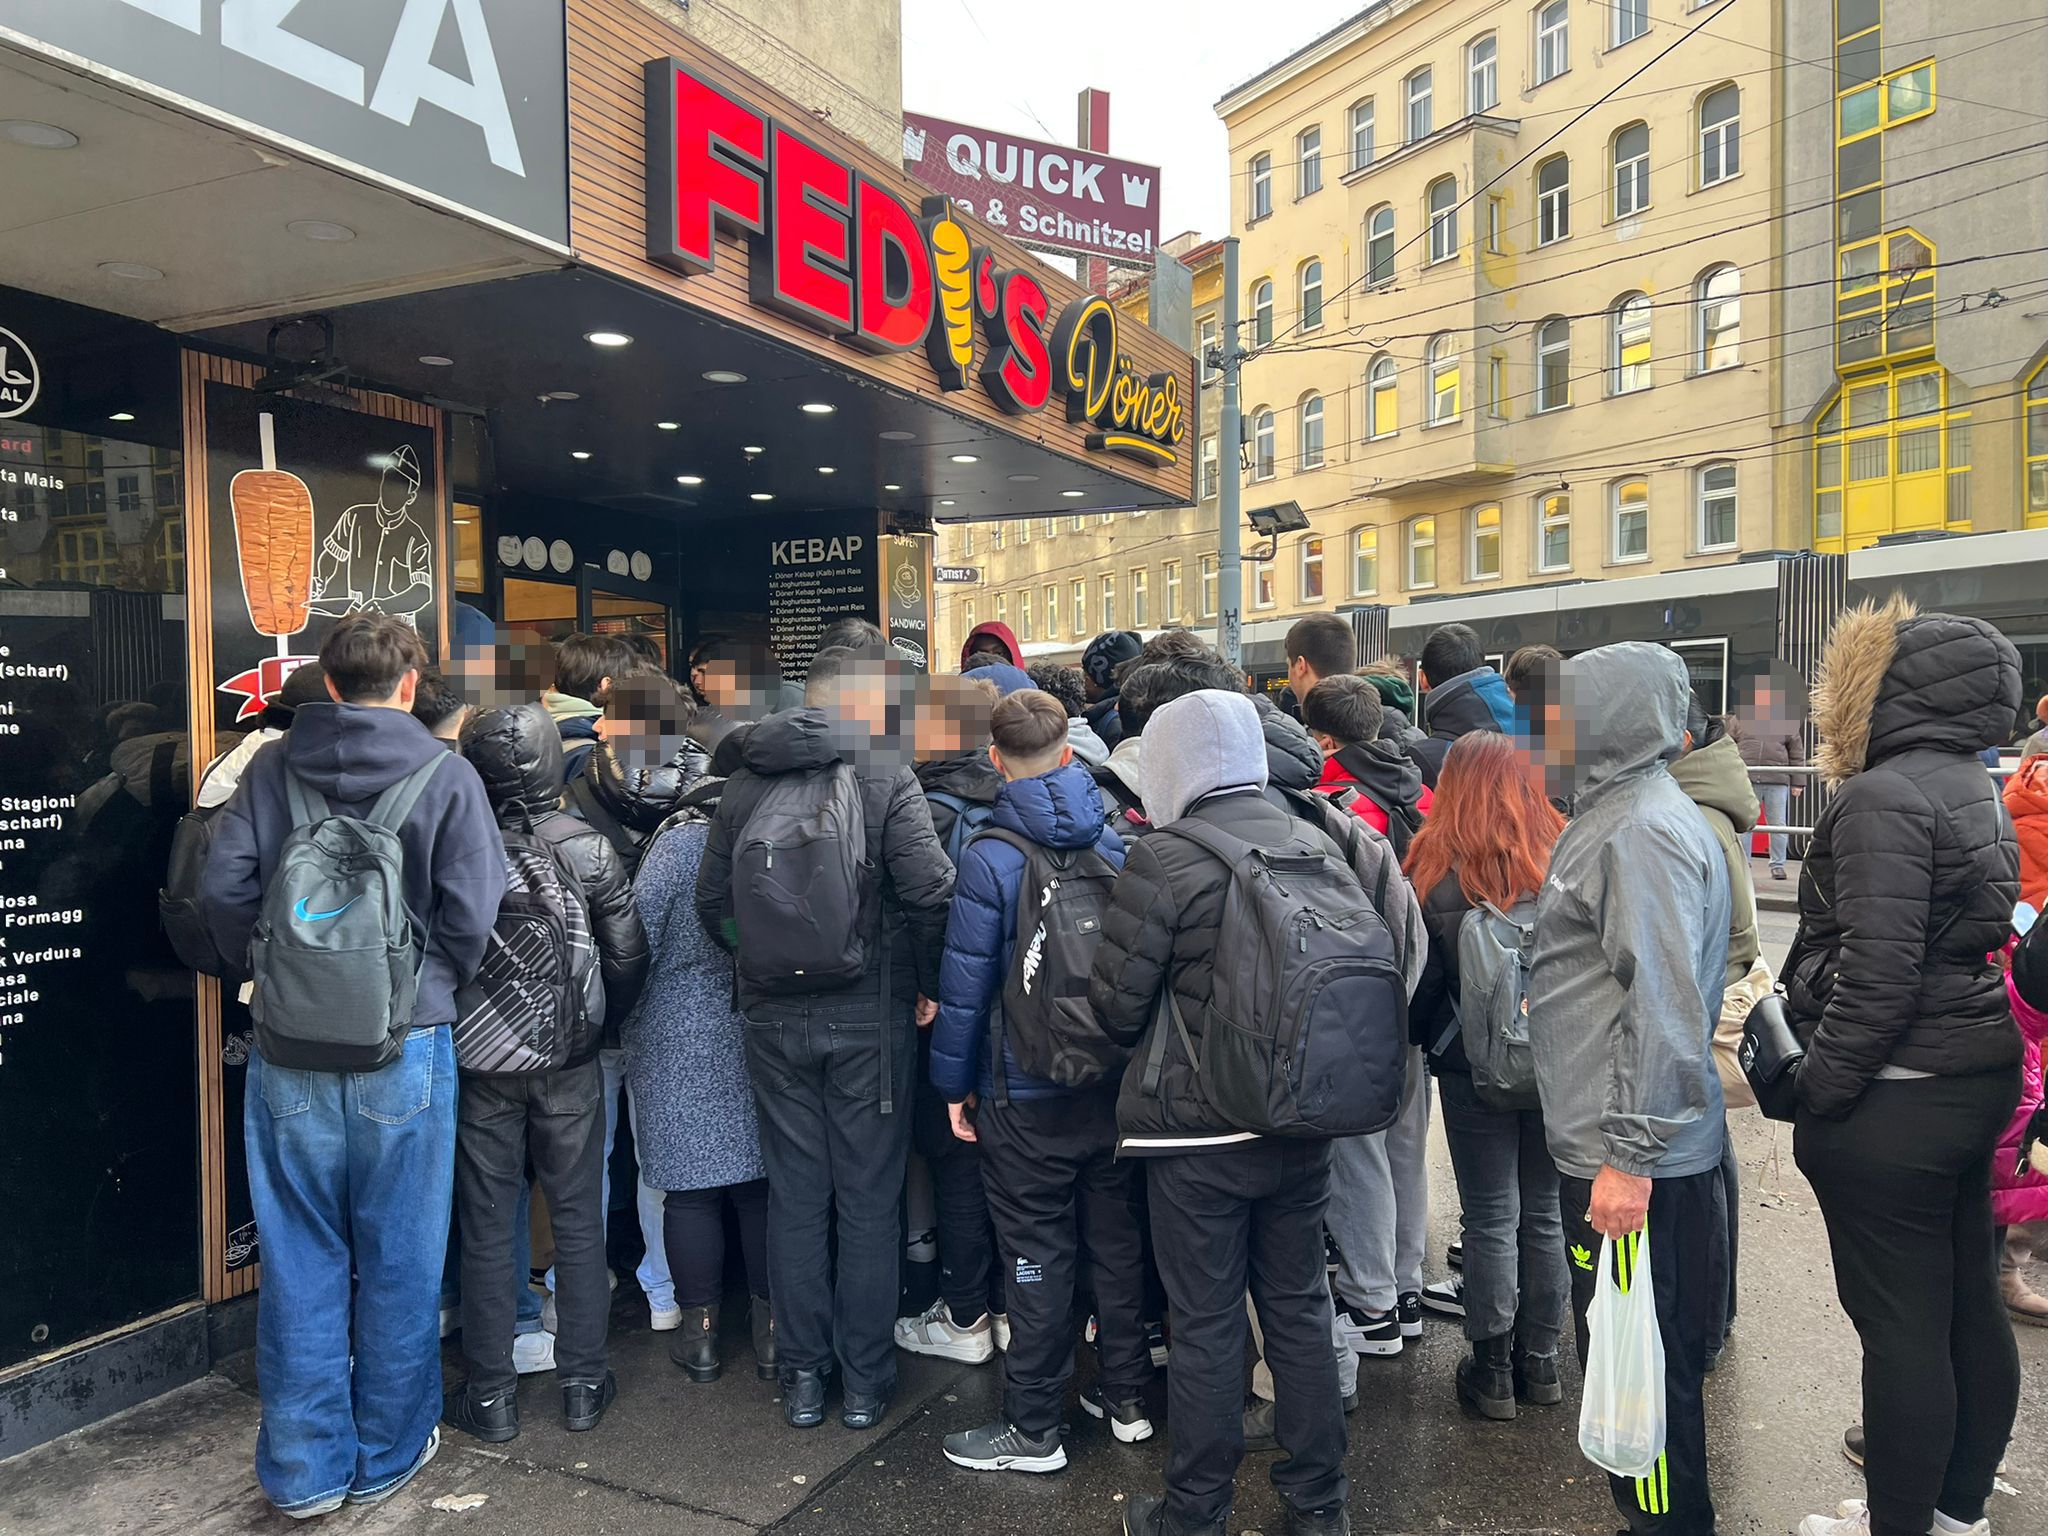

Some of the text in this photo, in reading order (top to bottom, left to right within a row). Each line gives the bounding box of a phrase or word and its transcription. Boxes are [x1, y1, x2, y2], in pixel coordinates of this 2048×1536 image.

[946, 134, 1105, 204] QUICK
[985, 198, 1009, 227] &
[1019, 204, 1152, 254] Schnitzel
[1062, 297, 1185, 446] Döner
[24, 471, 64, 490] Mais
[772, 536, 863, 565] KEBAP
[889, 616, 926, 631] SANDWICH
[0, 662, 69, 682] (scharf)
[1, 794, 76, 813] Stagioni
[5, 908, 83, 928] Formagg
